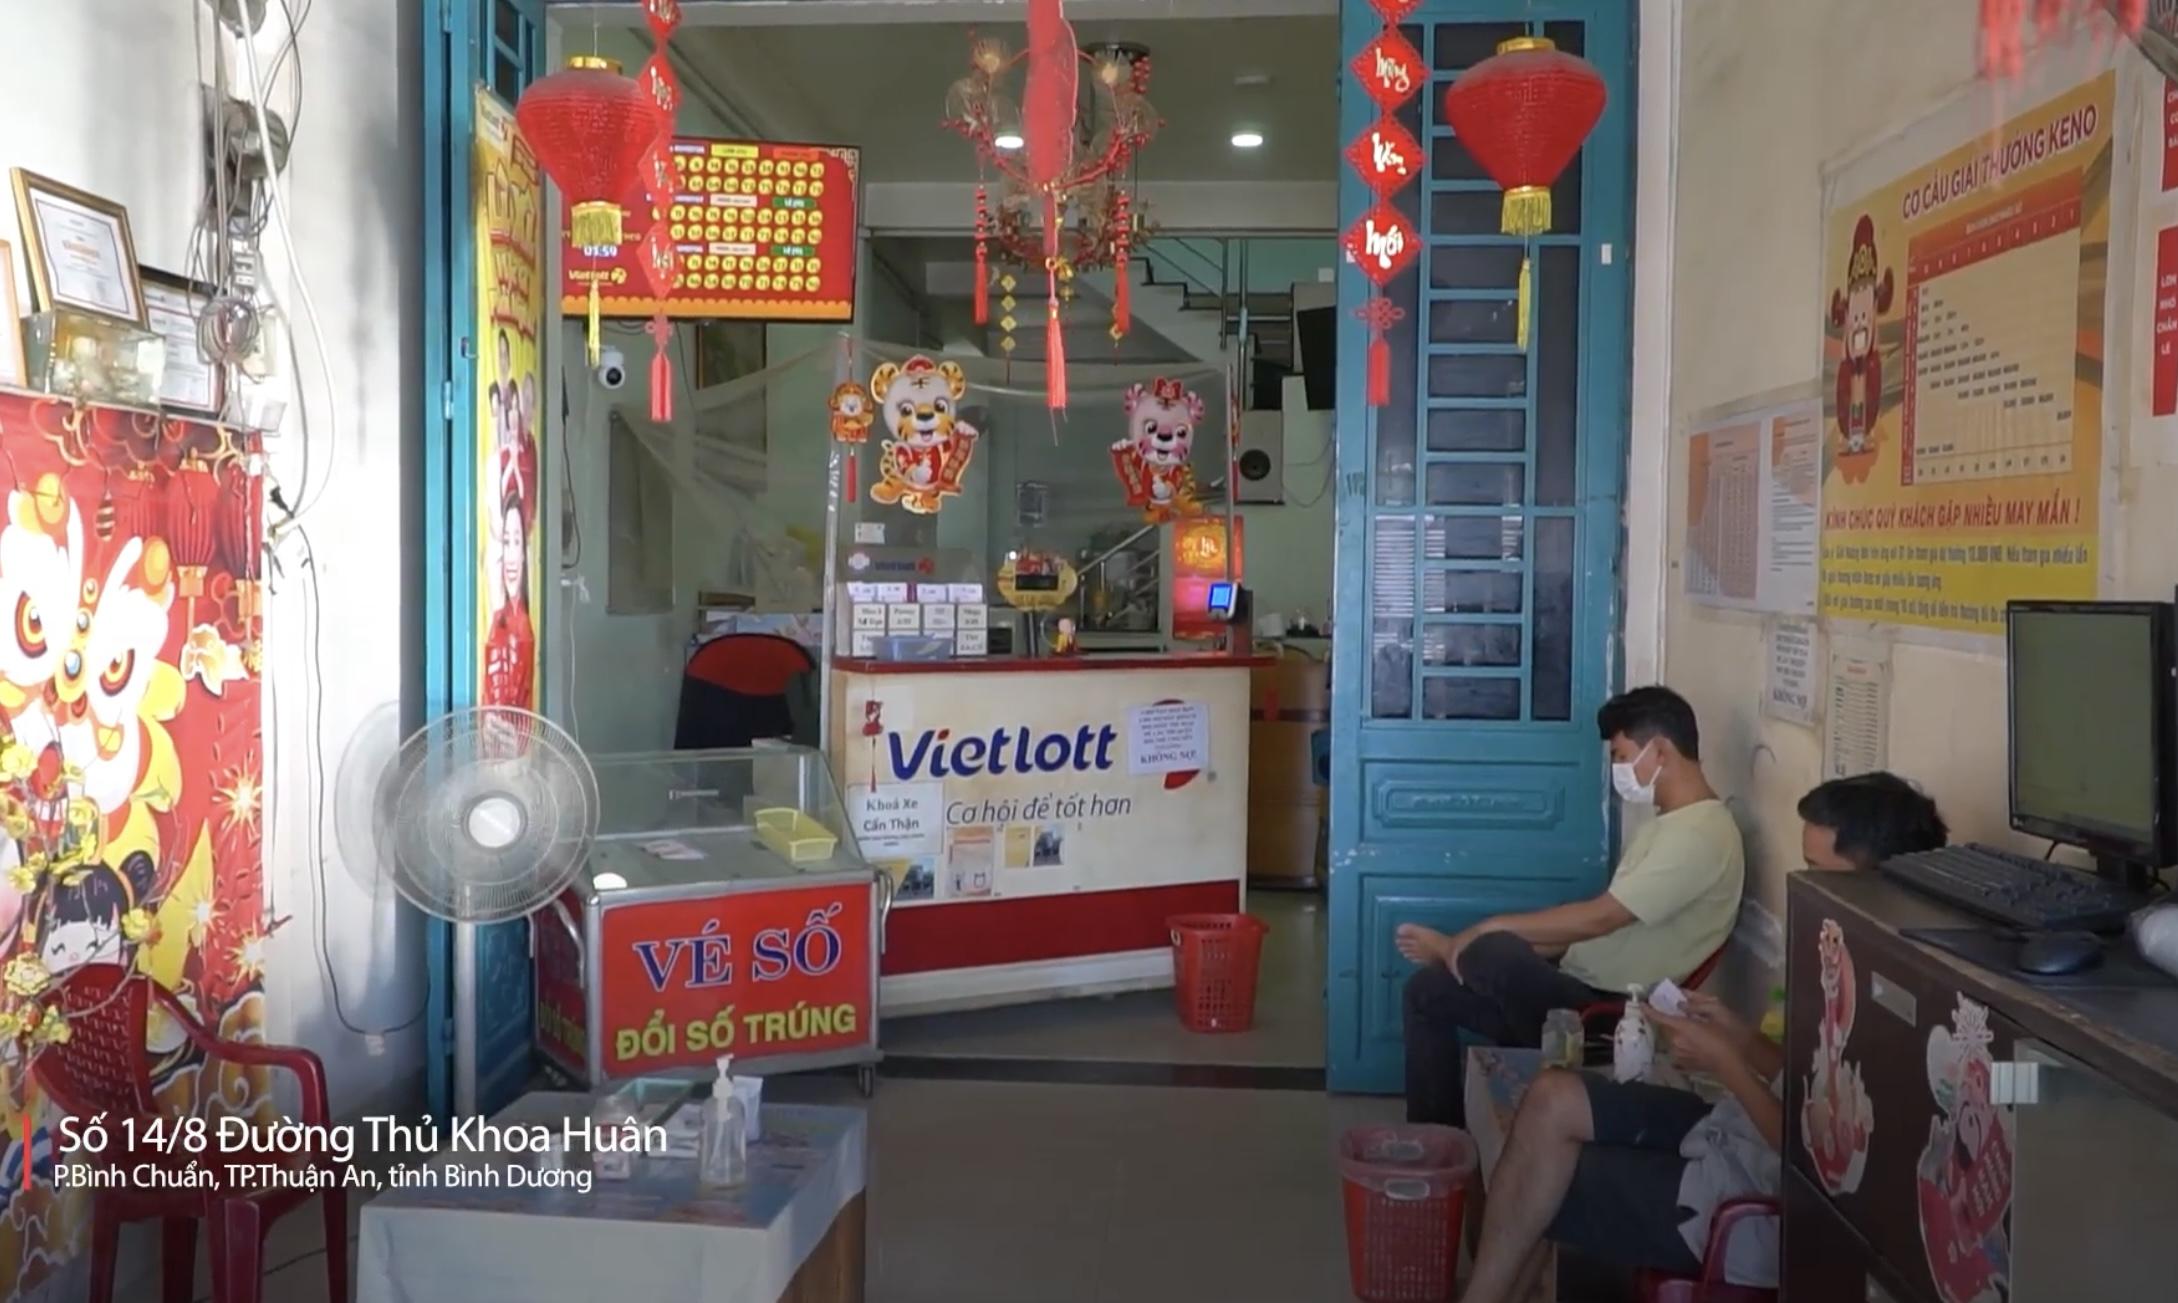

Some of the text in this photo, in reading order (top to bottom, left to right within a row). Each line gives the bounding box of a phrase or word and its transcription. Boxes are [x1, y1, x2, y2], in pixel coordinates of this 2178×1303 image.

[2048, 103, 2098, 153] KENO
[1899, 502, 1935, 528] KHÁCH
[2005, 501, 2034, 526] MAY
[888, 723, 1118, 782] Vietlott
[891, 817, 920, 832] Thận
[903, 798, 919, 810] Xe
[946, 791, 1132, 825] Cơ hội để tốt hơn
[633, 902, 844, 993] VÉ SỐ
[615, 1009, 676, 1061] ĐỔI
[685, 1006, 736, 1051] SỐ
[743, 999, 857, 1045] TRÚNG
